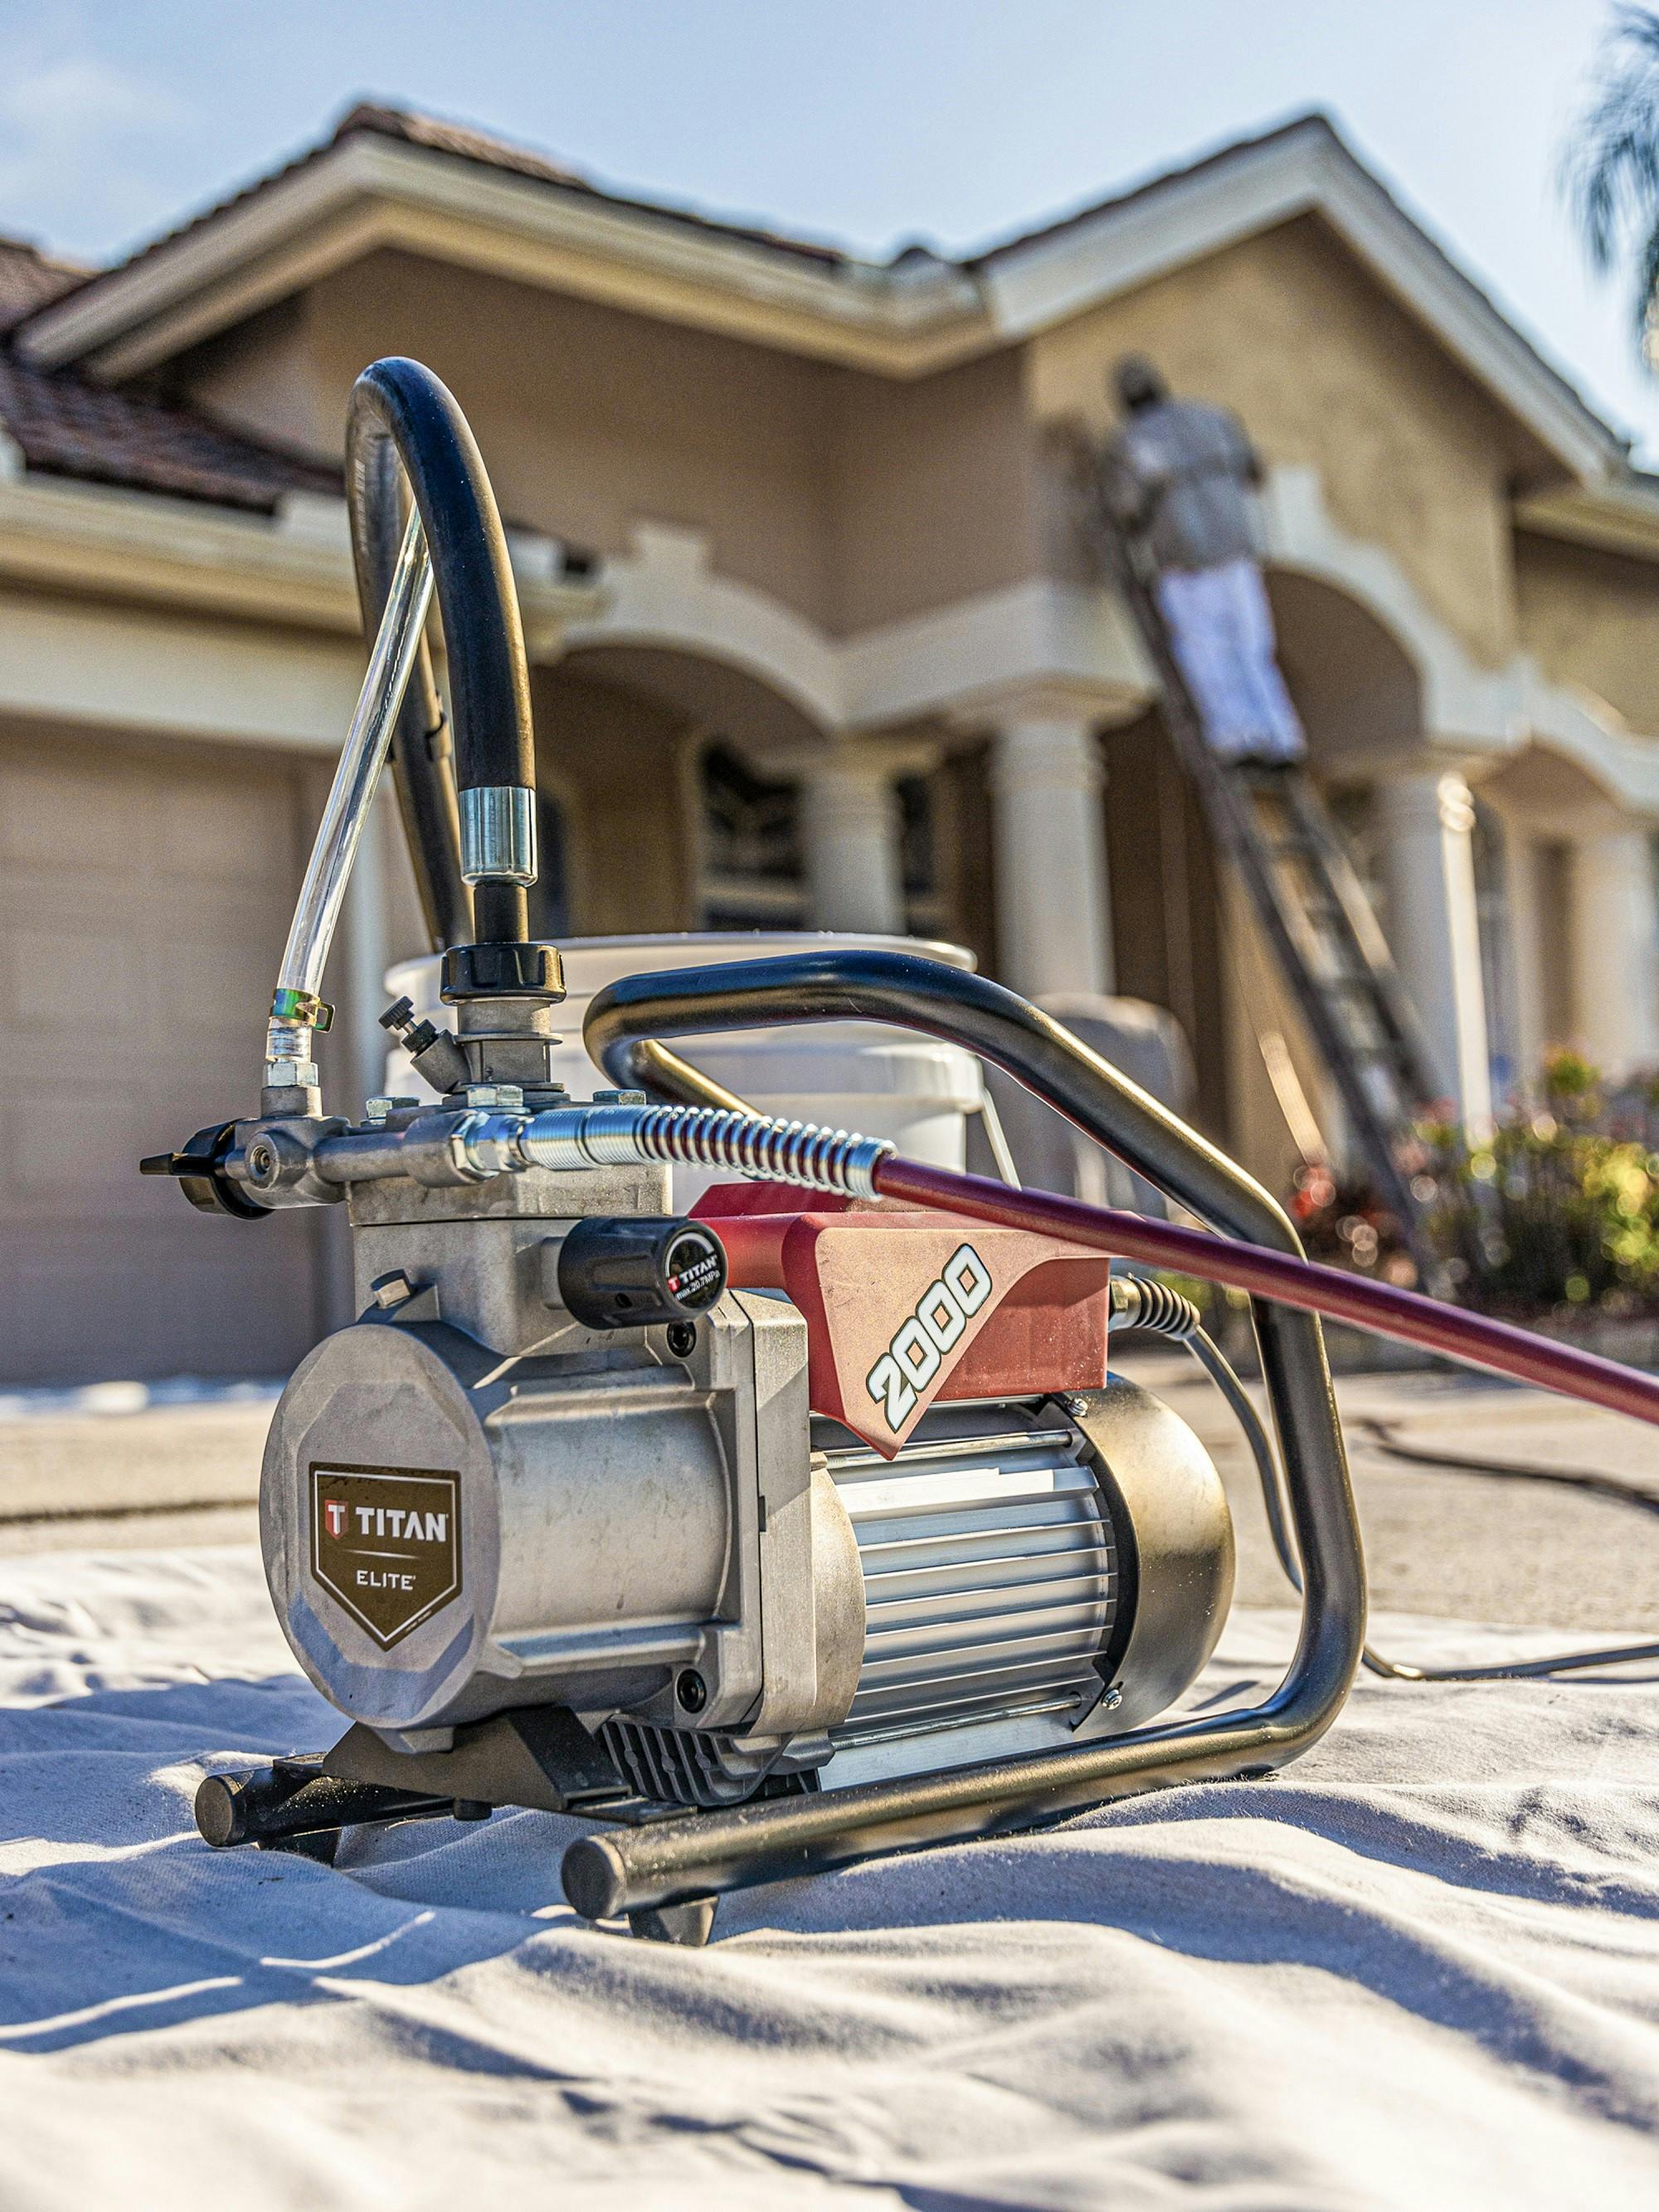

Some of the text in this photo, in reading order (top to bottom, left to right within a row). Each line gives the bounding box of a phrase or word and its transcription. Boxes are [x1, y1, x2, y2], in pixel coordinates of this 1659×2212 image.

[679, 1255, 718, 1284] TITAN
[866, 1242, 993, 1434] 2000
[328, 1504, 446, 1542] T TITAN
[357, 1570, 414, 1591] ELITE
